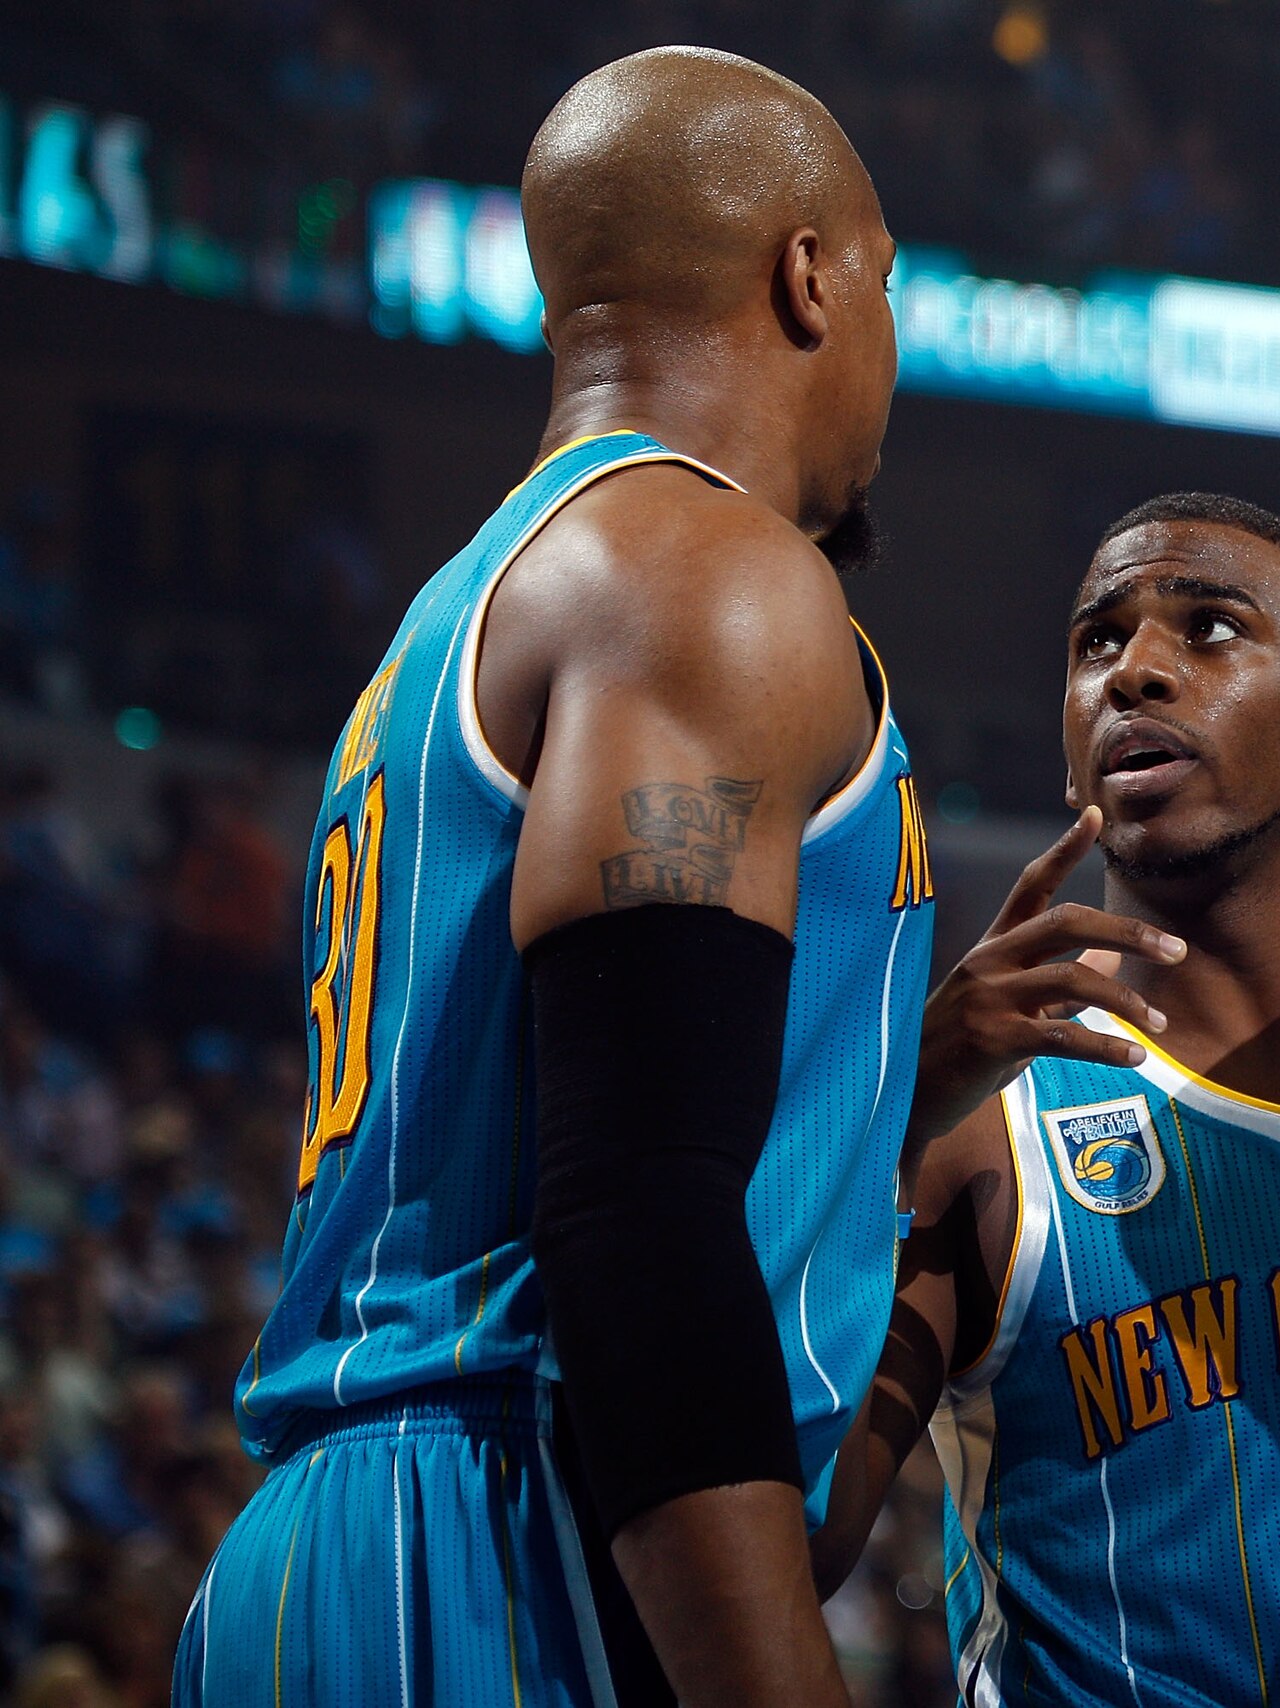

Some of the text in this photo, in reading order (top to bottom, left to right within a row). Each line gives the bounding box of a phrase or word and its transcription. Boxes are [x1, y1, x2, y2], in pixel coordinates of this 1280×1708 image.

[1077, 1109, 1135, 1127] BELIEVE IN
[1085, 1118, 1139, 1142] BLUE
[1094, 1200, 1120, 1211] GULF
[1057, 1273, 1243, 1461] NEW
